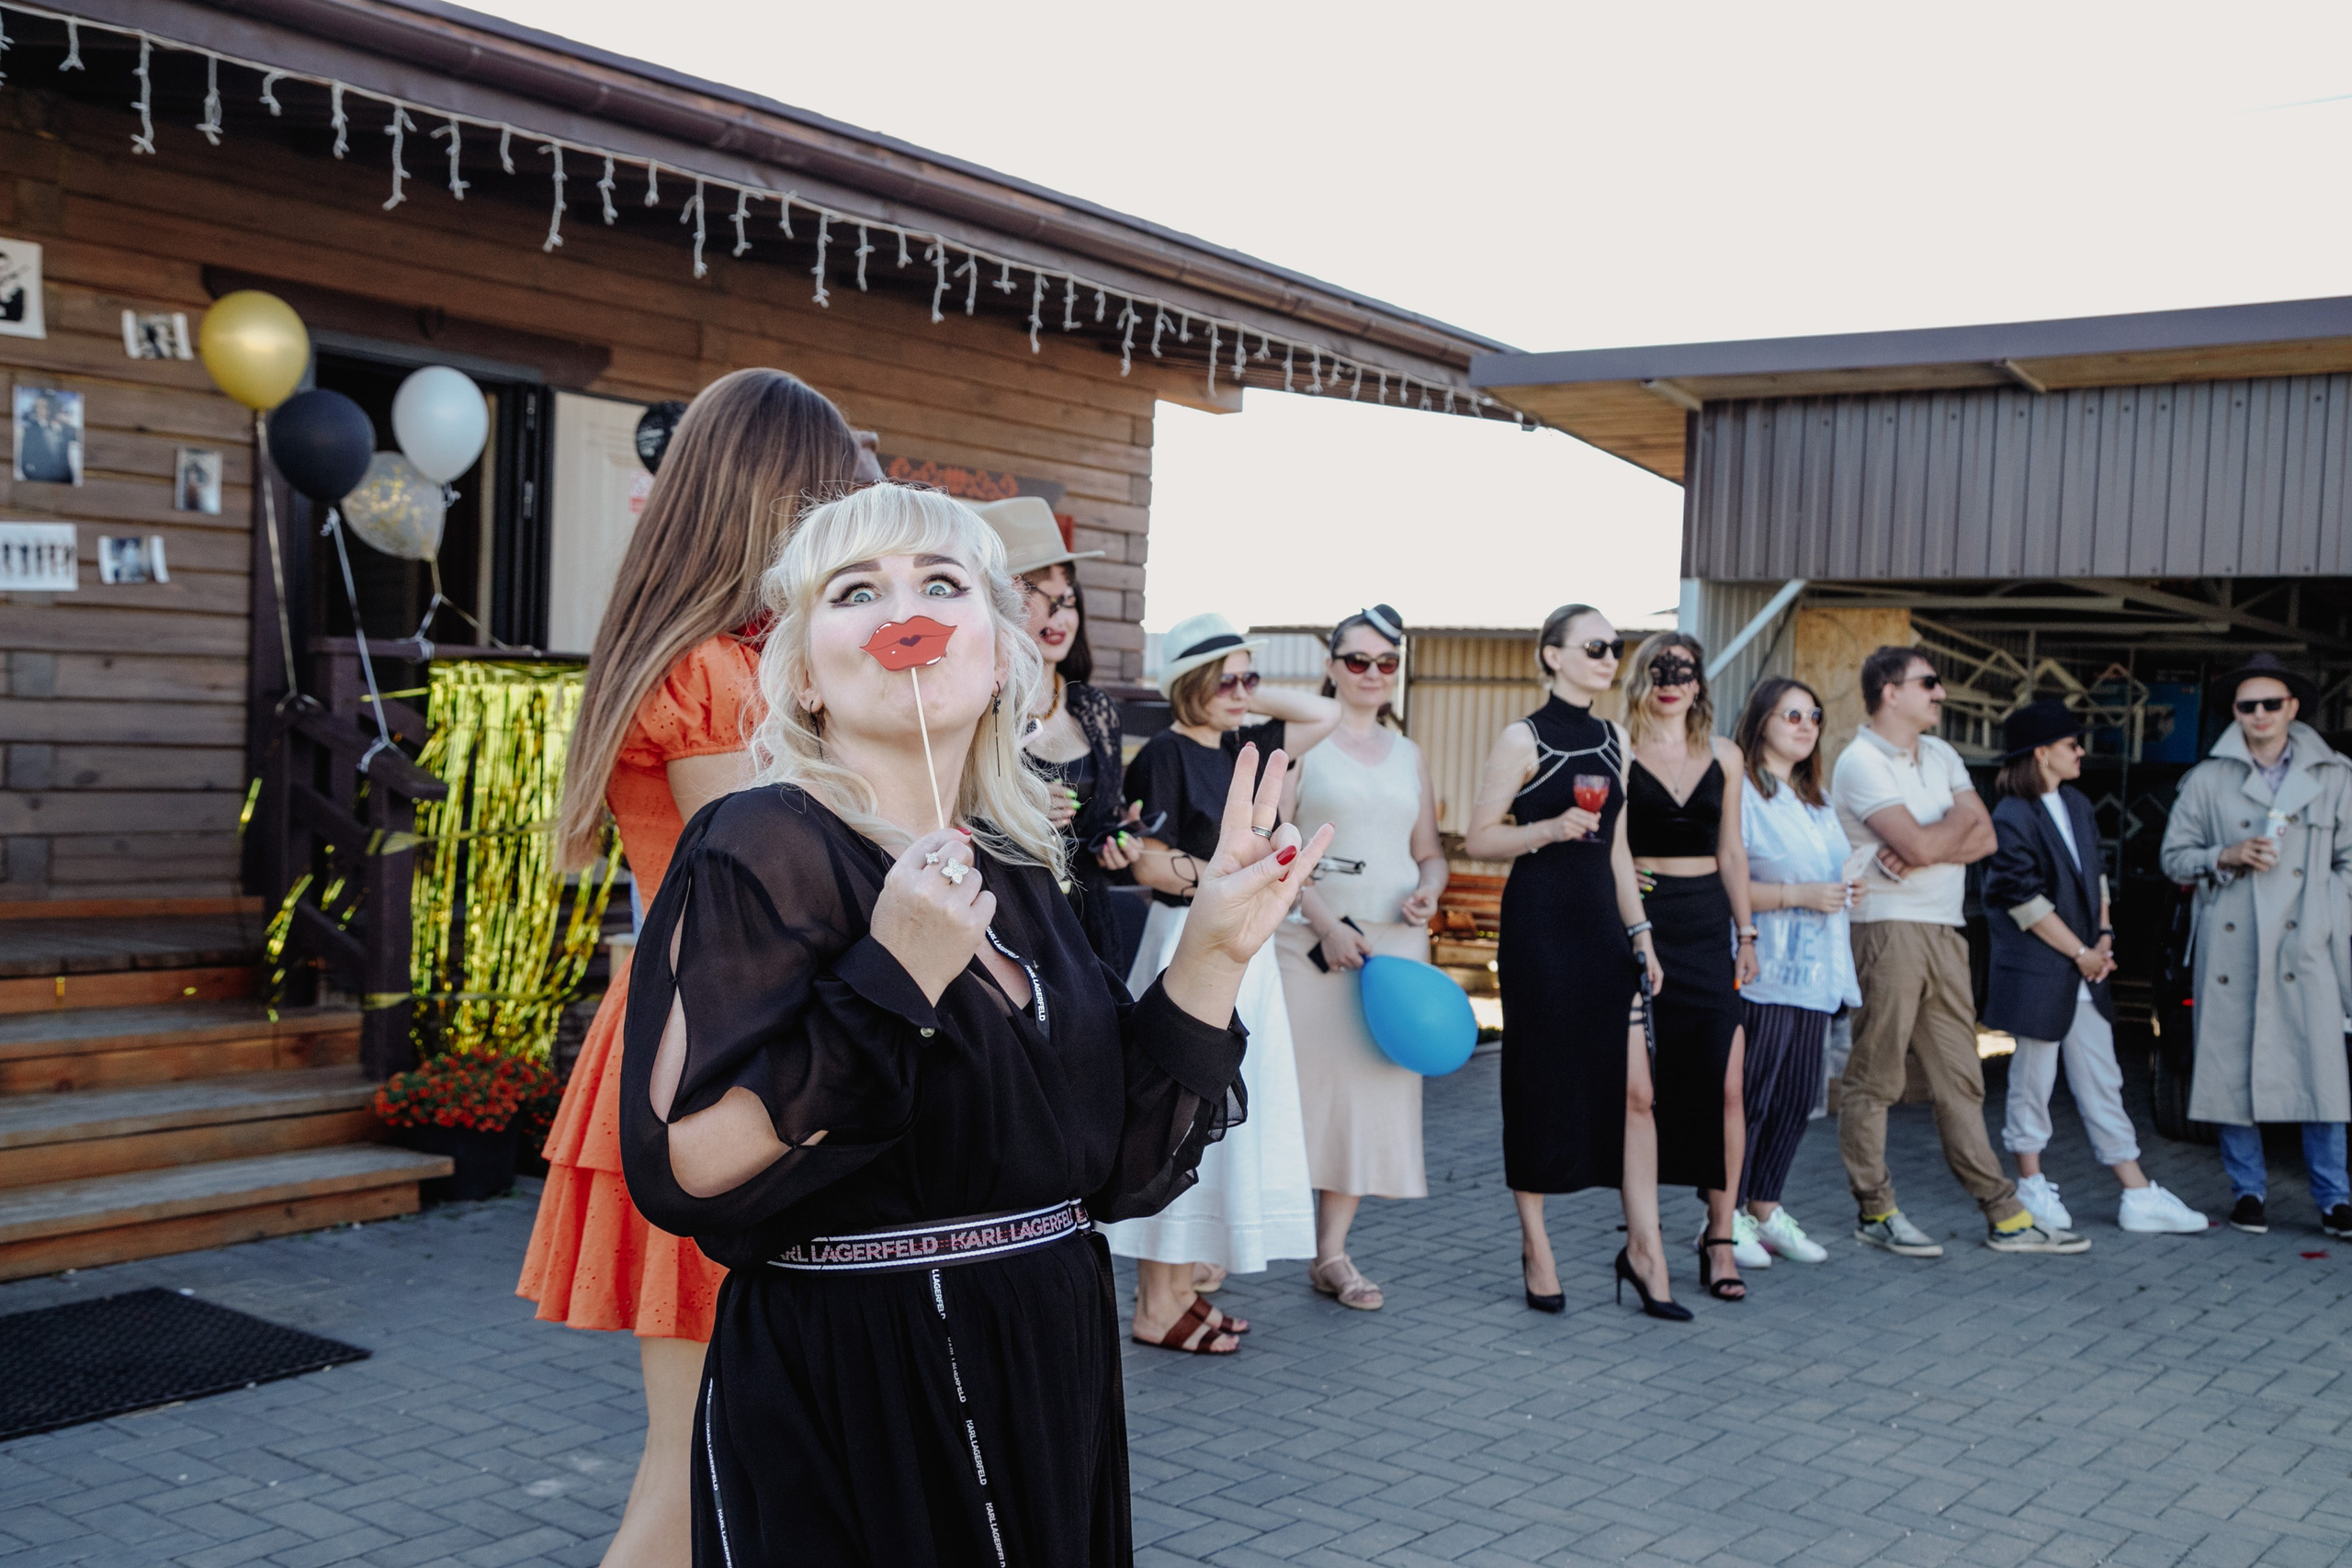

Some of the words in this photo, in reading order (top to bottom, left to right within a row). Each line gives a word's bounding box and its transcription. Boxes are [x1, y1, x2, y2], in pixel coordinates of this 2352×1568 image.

[1033, 978, 1046, 1021] LAGERFELD
[809, 1236, 938, 1263] LAGERFELD
[950, 1226, 1009, 1251] KARL
[1010, 1207, 1074, 1242] LAGERFEL
[966, 1419, 977, 1441] KARL
[971, 1440, 988, 1486] LAGERFELD
[985, 1502, 997, 1524] KARL
